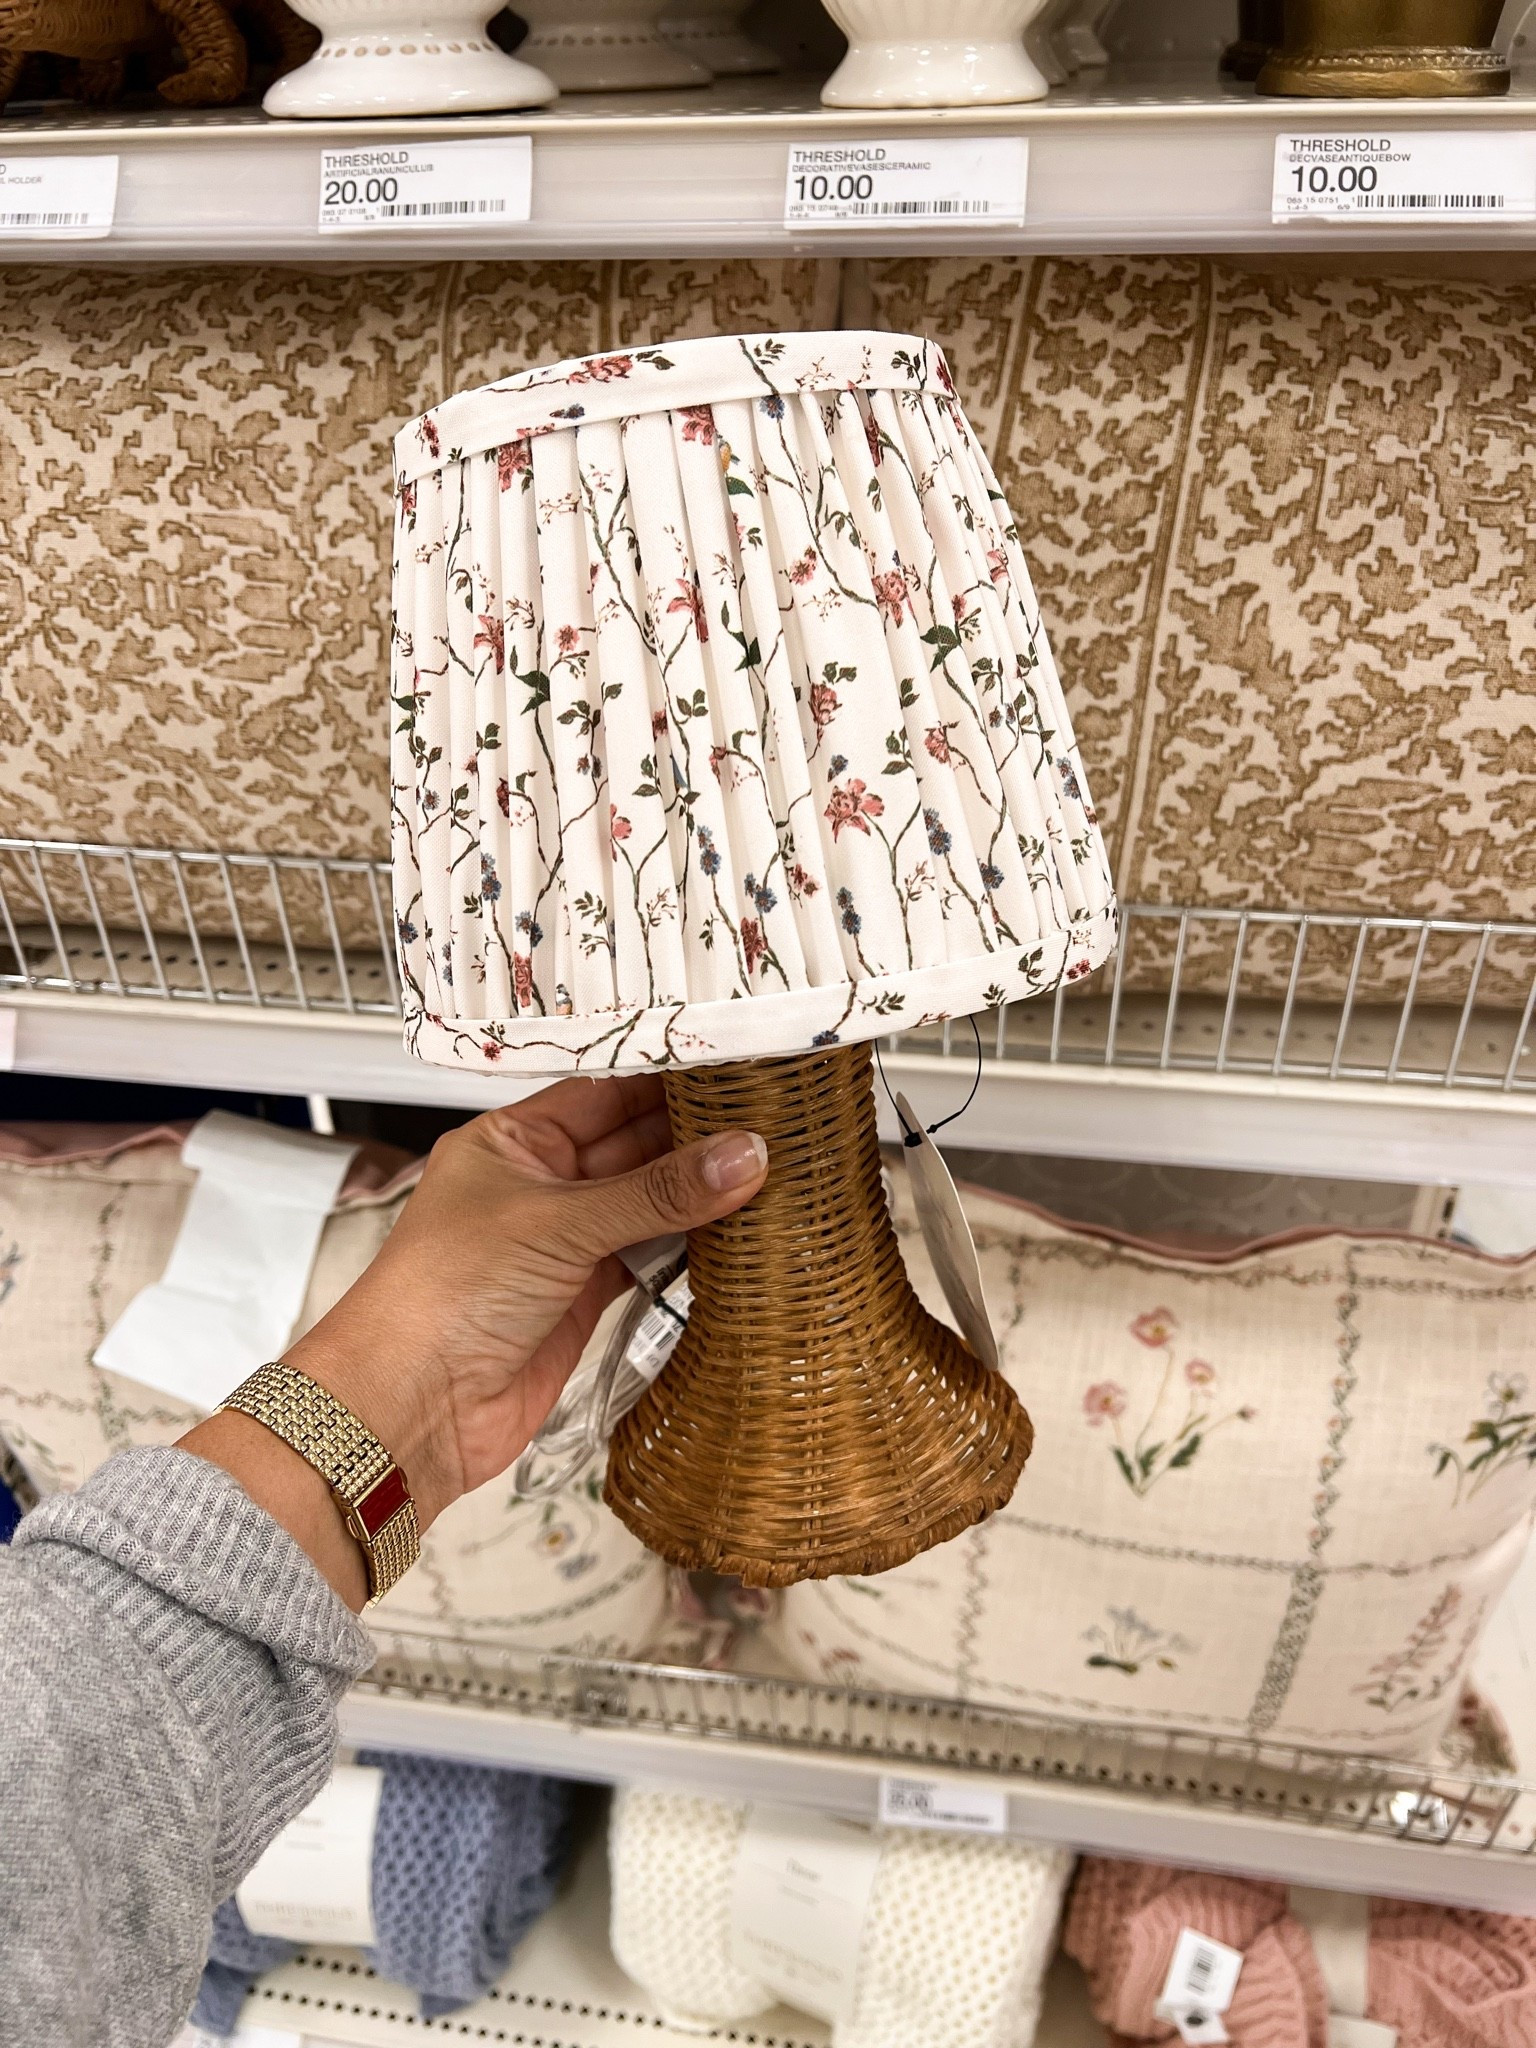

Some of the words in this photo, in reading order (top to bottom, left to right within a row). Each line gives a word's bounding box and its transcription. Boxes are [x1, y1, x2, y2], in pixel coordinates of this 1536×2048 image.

[1290, 138, 1391, 152] THRESHOLD
[325, 151, 409, 169] THRESHOLD
[794, 148, 886, 163] THRESHOLD
[1289, 153, 1412, 163] DECVASEANTIQUEBOW
[794, 174, 873, 200] 10.00
[1291, 165, 1378, 193] 10.00
[324, 177, 398, 205] 20.00
